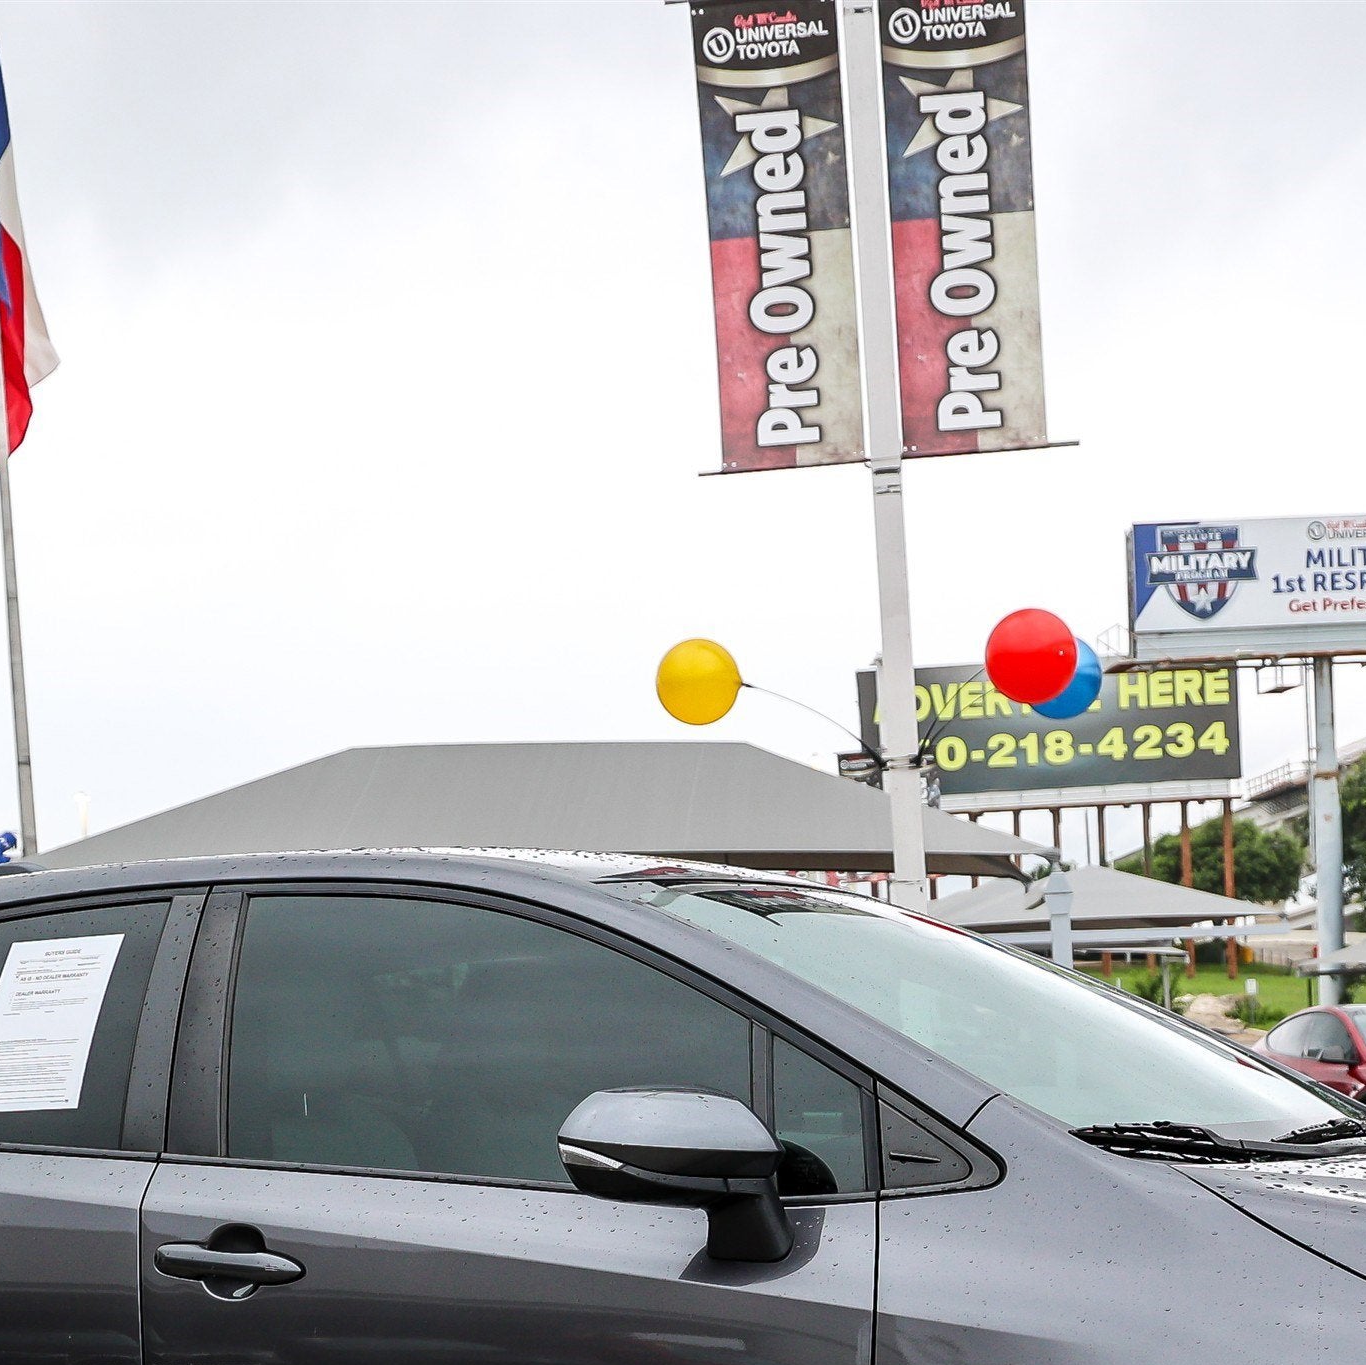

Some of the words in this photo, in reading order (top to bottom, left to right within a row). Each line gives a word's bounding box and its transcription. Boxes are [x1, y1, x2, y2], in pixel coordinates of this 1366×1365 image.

[921, 2, 1016, 24] UNIVERSAL
[735, 20, 829, 43] UNIVERSAL
[922, 21, 986, 41] TOYOTA
[736, 40, 800, 60] TOYOTA
[919, 91, 997, 317] Owned
[735, 109, 816, 334] Owned
[938, 329, 1003, 432] Pre
[757, 346, 820, 447] Pre
[1151, 552, 1251, 574] MILITARY
[1272, 574, 1306, 593] 1st
[1288, 598, 1318, 613] Get
[1120, 668, 1231, 710] HERE
[919, 720, 1231, 772] 0-218-4234
